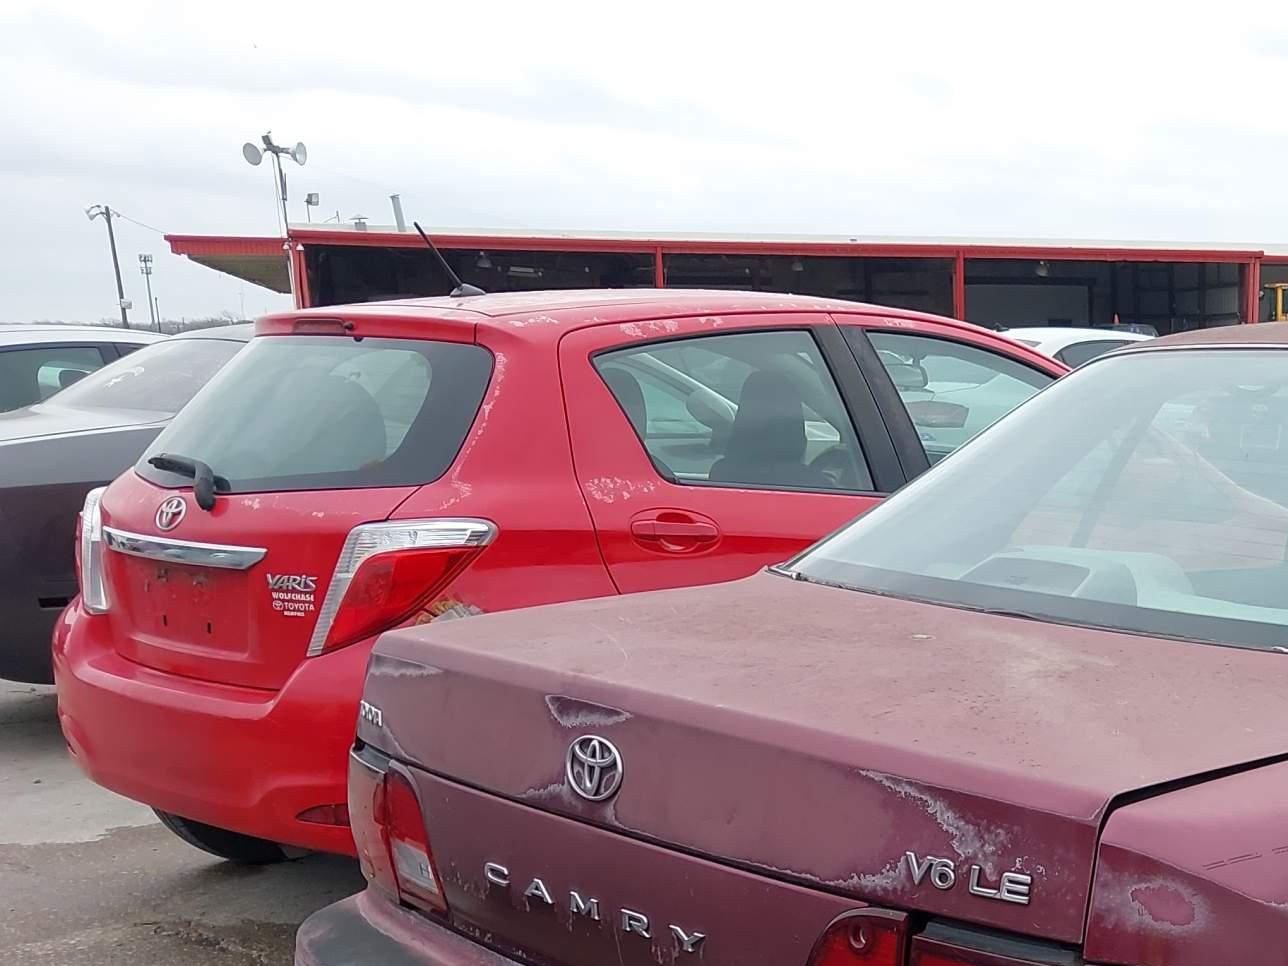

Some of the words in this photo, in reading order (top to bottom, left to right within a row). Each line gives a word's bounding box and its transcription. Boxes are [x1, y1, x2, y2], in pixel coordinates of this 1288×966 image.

[271, 591, 315, 602] WOLFCHASE
[284, 602, 315, 611] TOYOTA
[906, 851, 955, 889] V6
[968, 864, 1032, 905] LE
[484, 862, 705, 952] CAMRY
